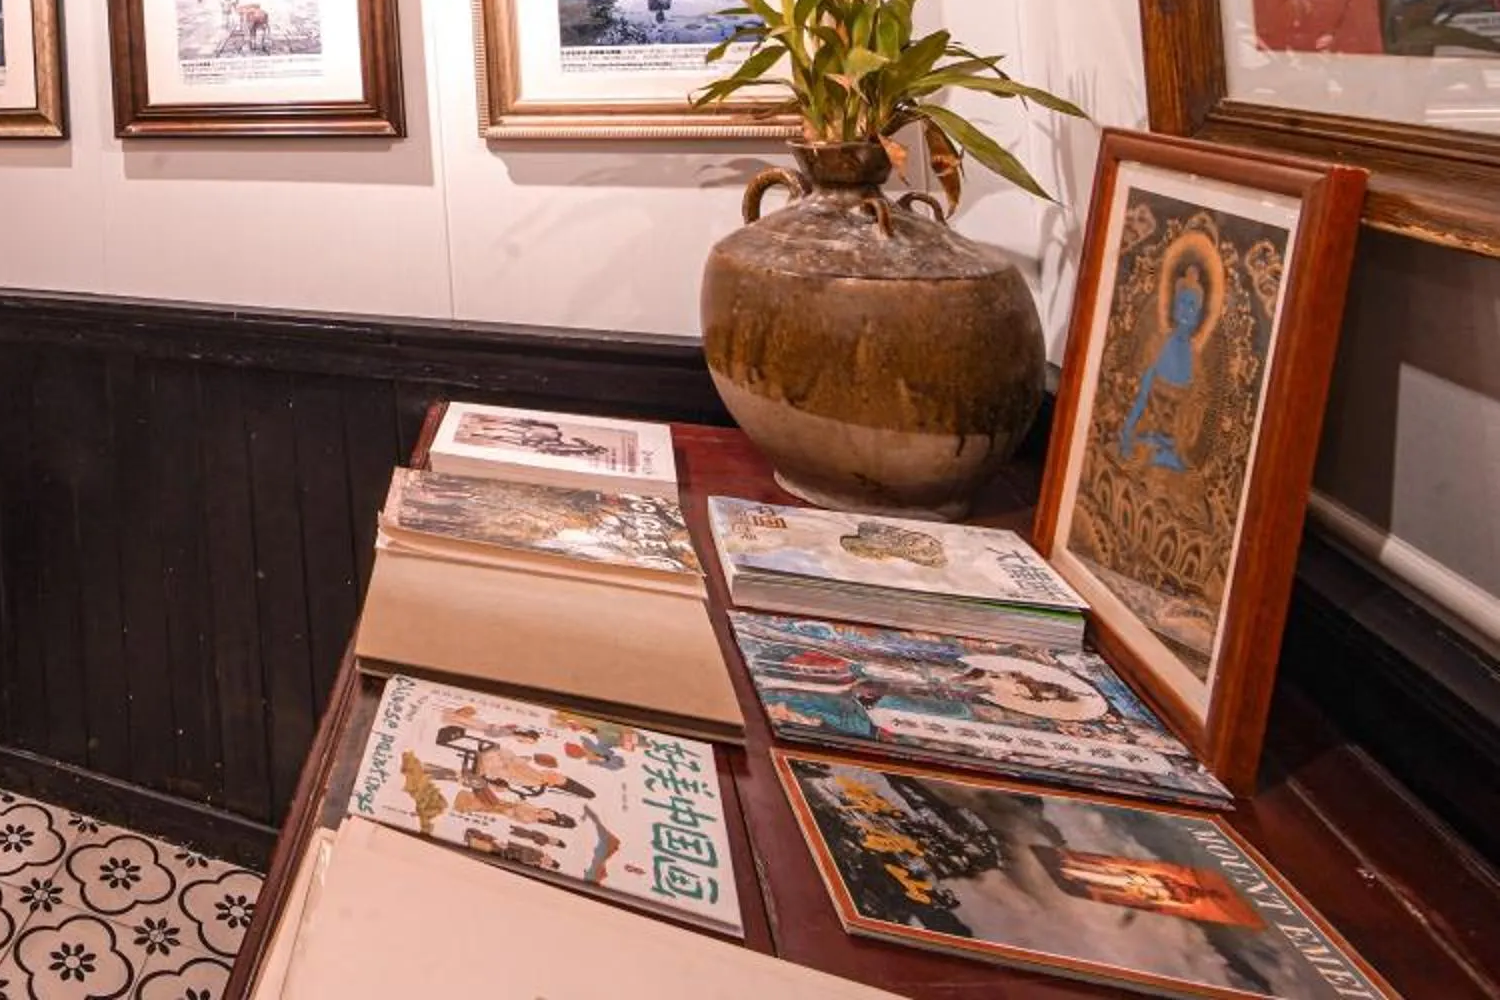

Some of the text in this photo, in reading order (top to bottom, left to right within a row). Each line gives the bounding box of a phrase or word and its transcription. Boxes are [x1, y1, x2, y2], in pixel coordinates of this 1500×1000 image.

[641, 740, 719, 905] 好美中国画
[1187, 826, 1375, 999] MOUNT EMEI
